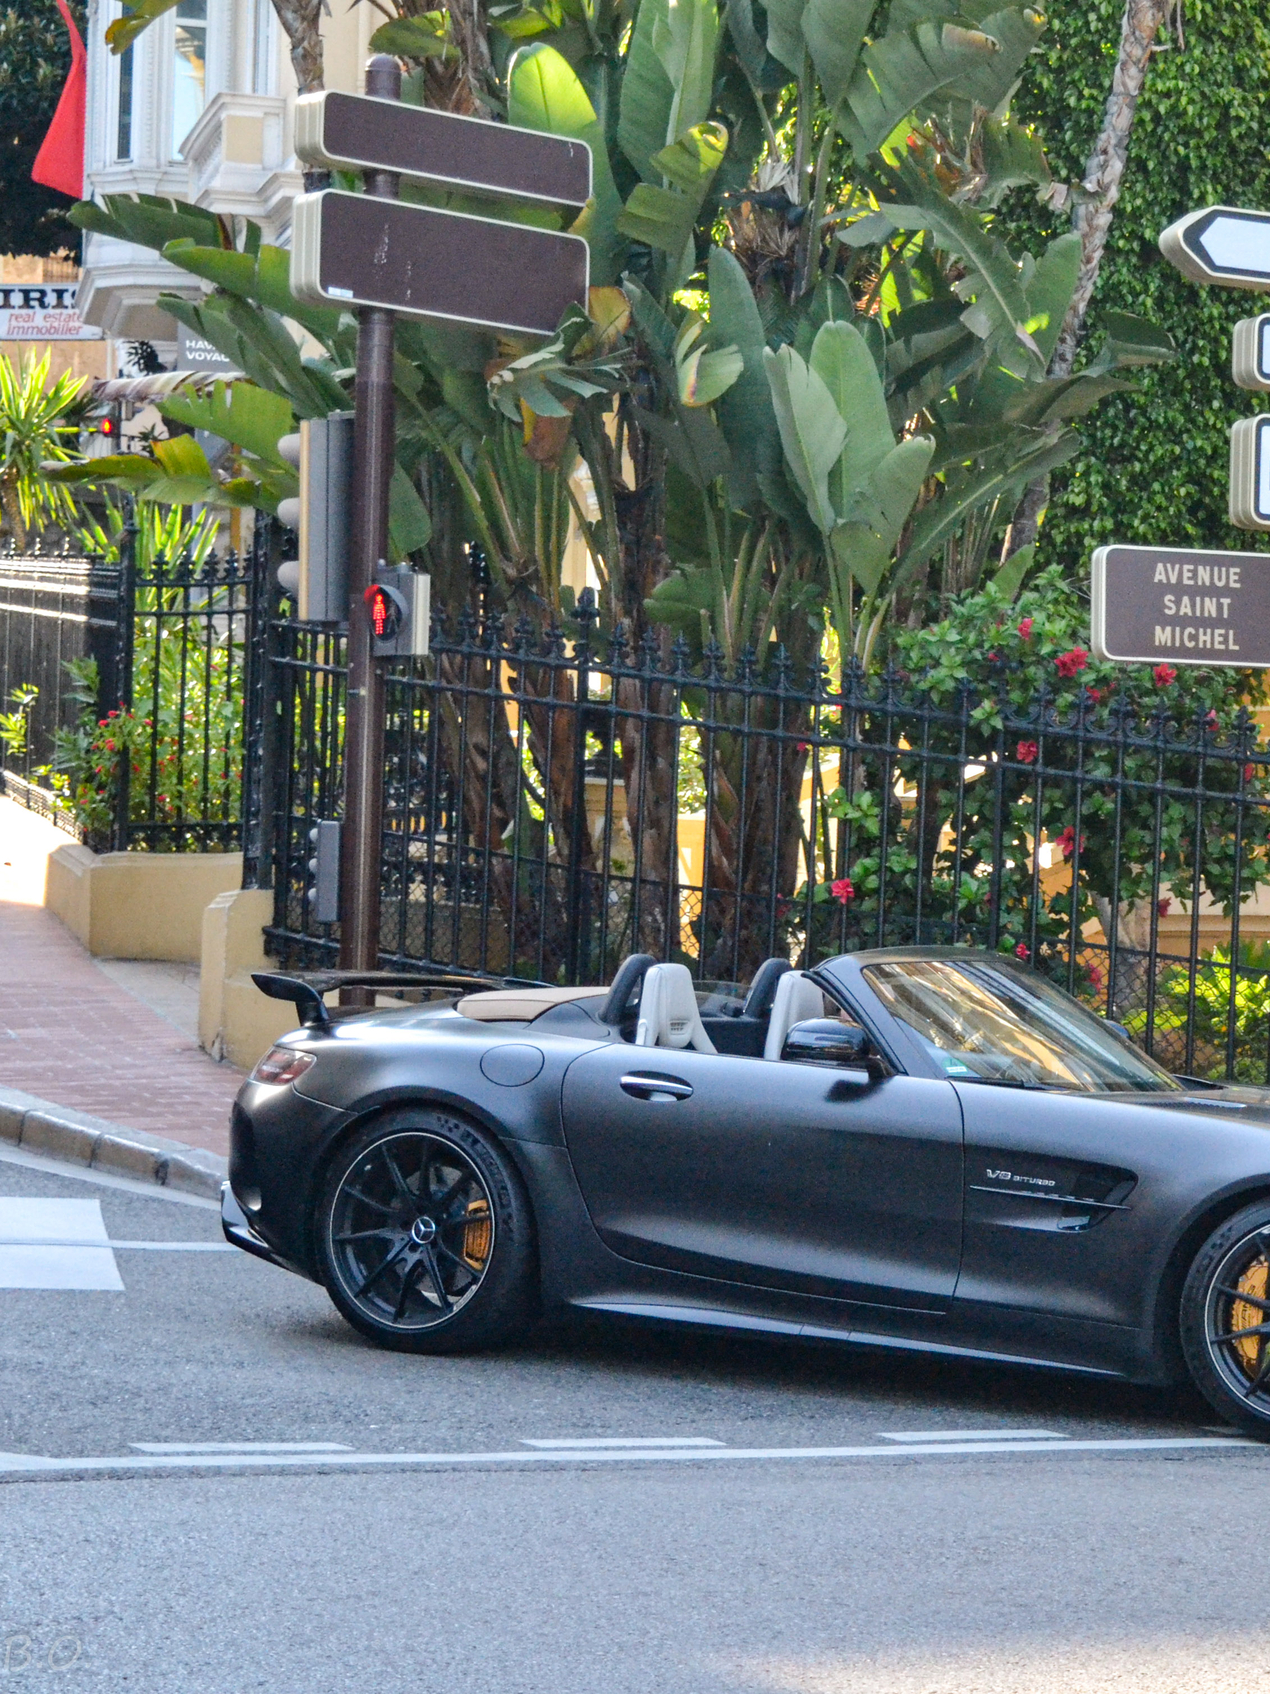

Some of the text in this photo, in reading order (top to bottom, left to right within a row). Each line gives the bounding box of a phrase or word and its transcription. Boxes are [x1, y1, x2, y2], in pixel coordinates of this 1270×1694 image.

[8, 311, 36, 323] real
[7, 323, 83, 336] immobilier
[1154, 563, 1241, 588] AVENUE
[1164, 595, 1231, 618] SAINT
[1154, 626, 1240, 651] MICHEL
[986, 1168, 1056, 1186] V8 BITURBO
